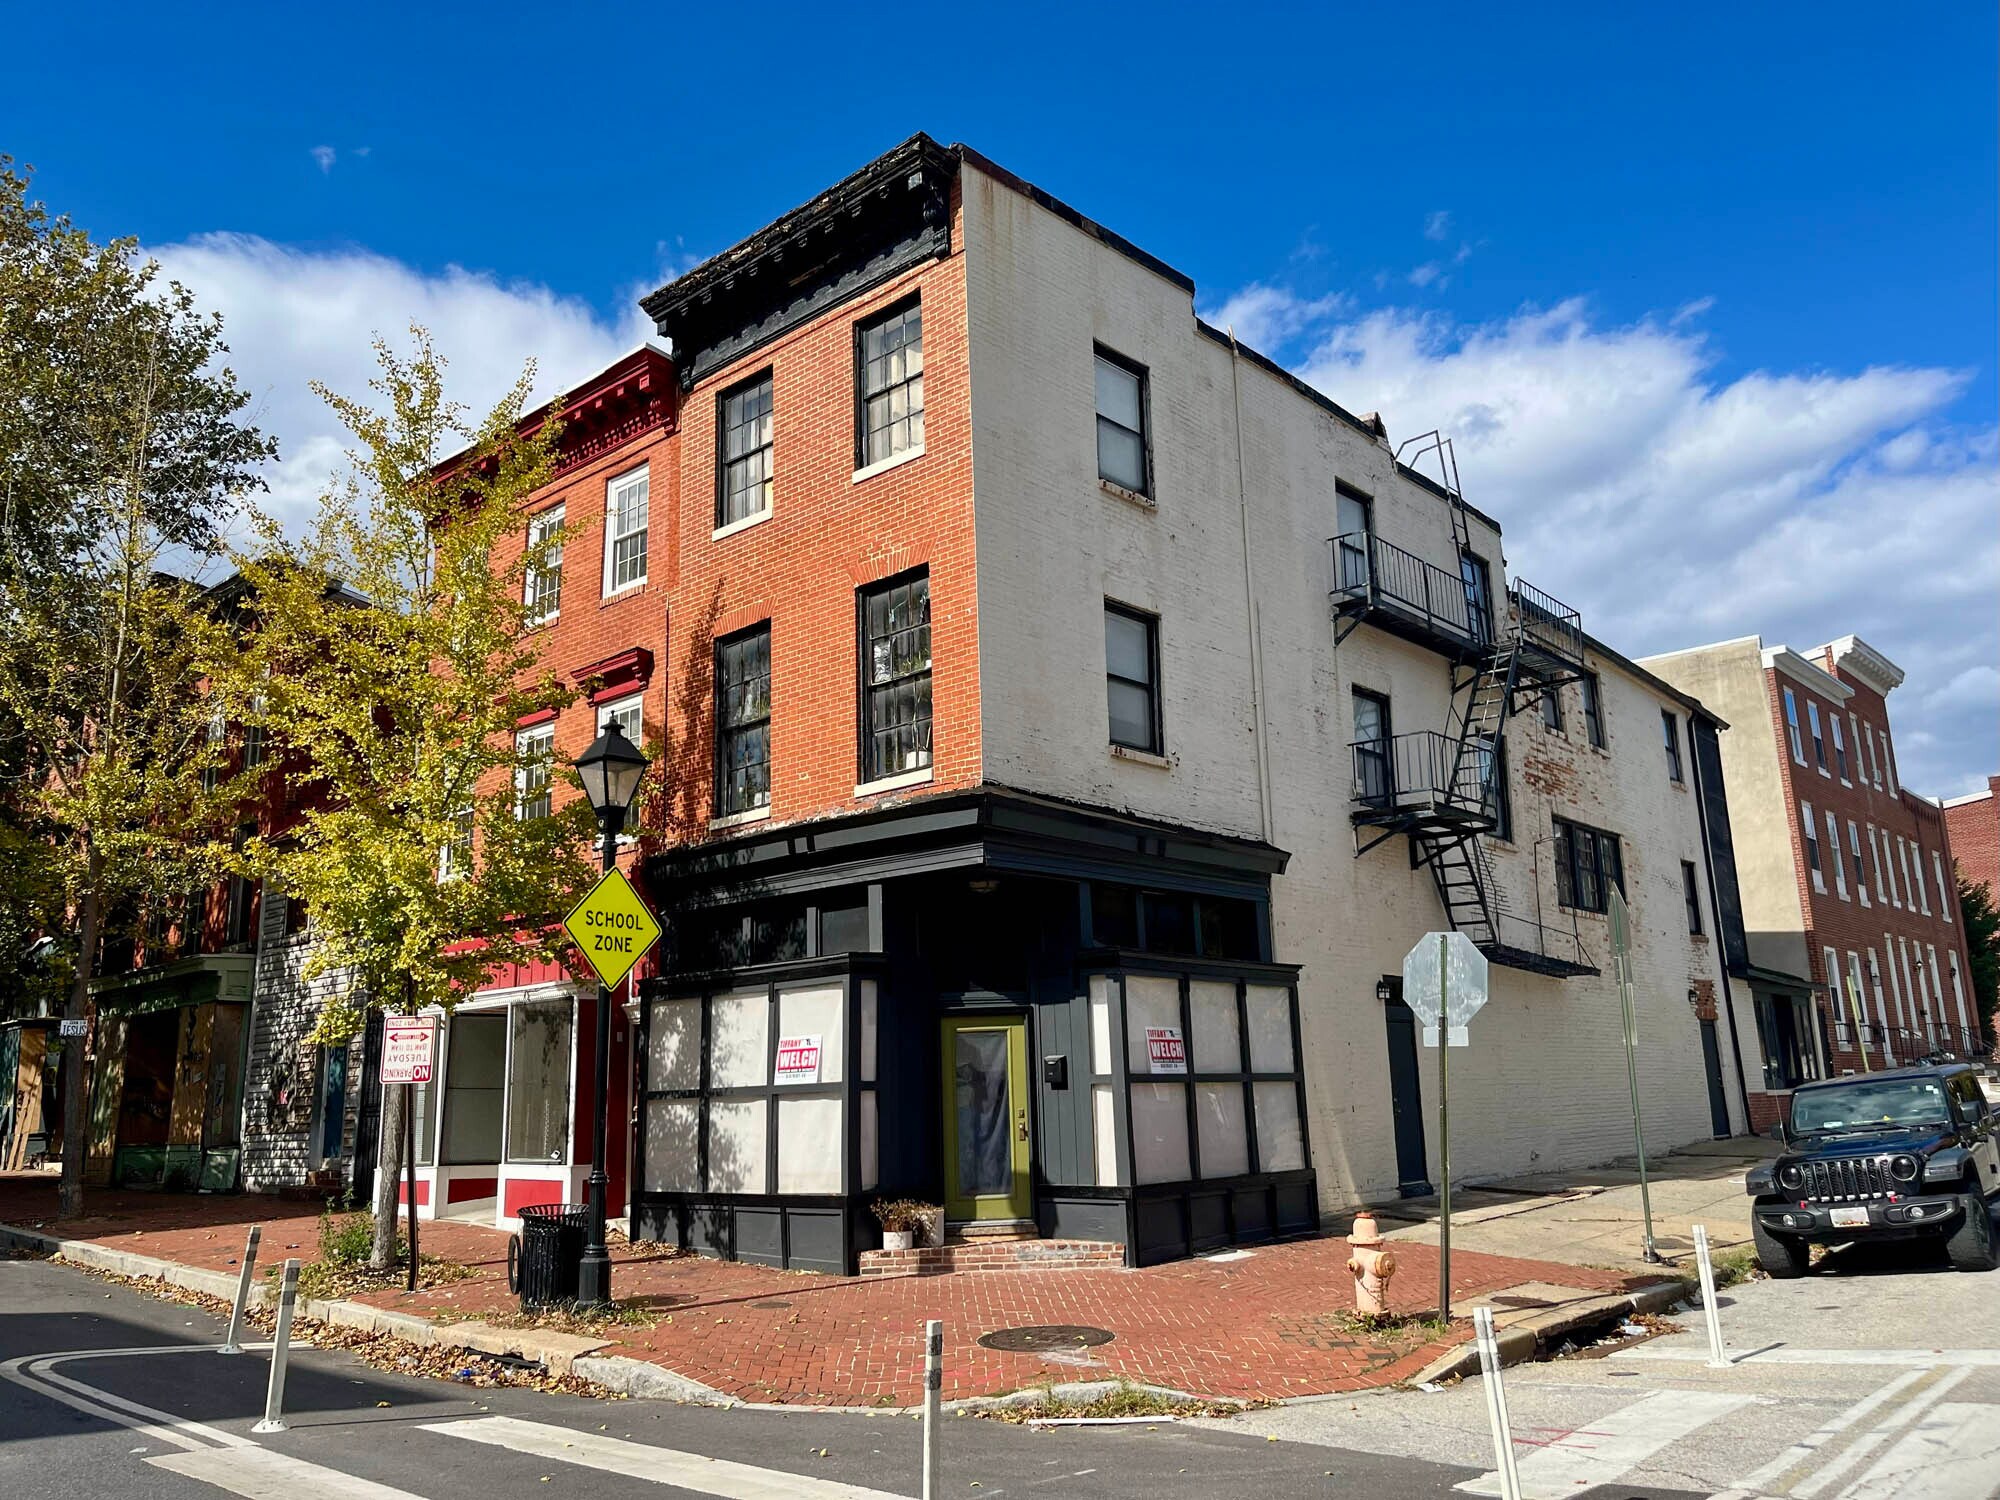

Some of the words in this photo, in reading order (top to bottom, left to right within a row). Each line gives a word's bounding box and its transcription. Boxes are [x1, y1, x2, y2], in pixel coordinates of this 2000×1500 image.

[585, 910, 643, 931] SCHOOL
[594, 935, 633, 953] ZONE
[63, 1024, 87, 1036] JESUS
[780, 1039, 802, 1048] TIFFANY
[1150, 1041, 1183, 1058] WELCH
[388, 1053, 427, 1062] TUESDAY
[779, 1049, 817, 1068] WELCH
[384, 1068, 412, 1078] PARKING
[413, 1066, 429, 1079] NO
